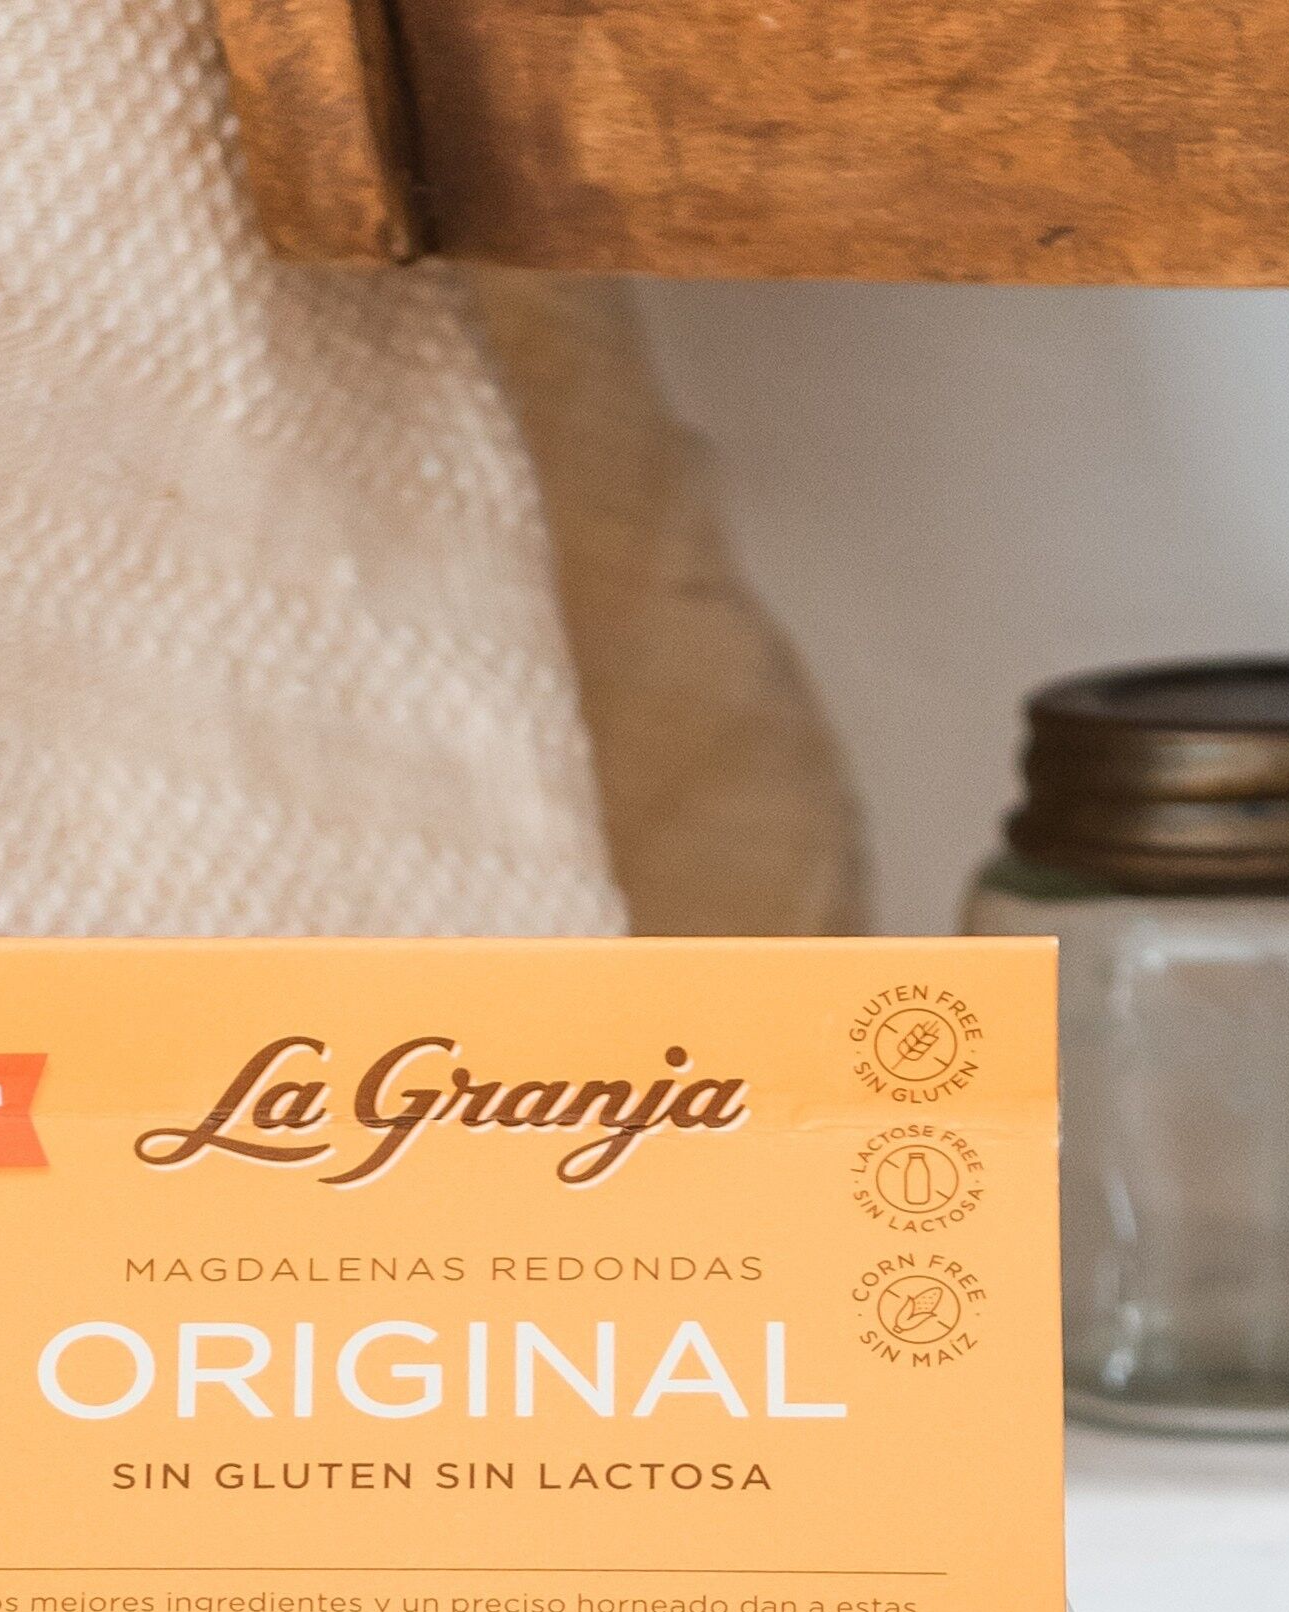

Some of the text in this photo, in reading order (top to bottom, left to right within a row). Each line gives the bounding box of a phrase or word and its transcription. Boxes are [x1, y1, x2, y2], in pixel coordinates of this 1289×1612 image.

[849, 984, 984, 1043] GLUTEN FREE
[853, 1060, 980, 1104] SIN GLUTEN
[133, 1035, 746, 1186] La Granja
[850, 1124, 984, 1174] LACTOSE FREE
[853, 1186, 984, 1233] SIN LACTOSA
[125, 1256, 762, 1283] MAGDALENAS REDONDAS
[851, 1252, 987, 1303] CORN FREE
[37, 1320, 848, 1420] ORIGINAL
[860, 1329, 900, 1363] SIN
[113, 1462, 771, 1491] SIN GLUTEN SIN LACTOSA
